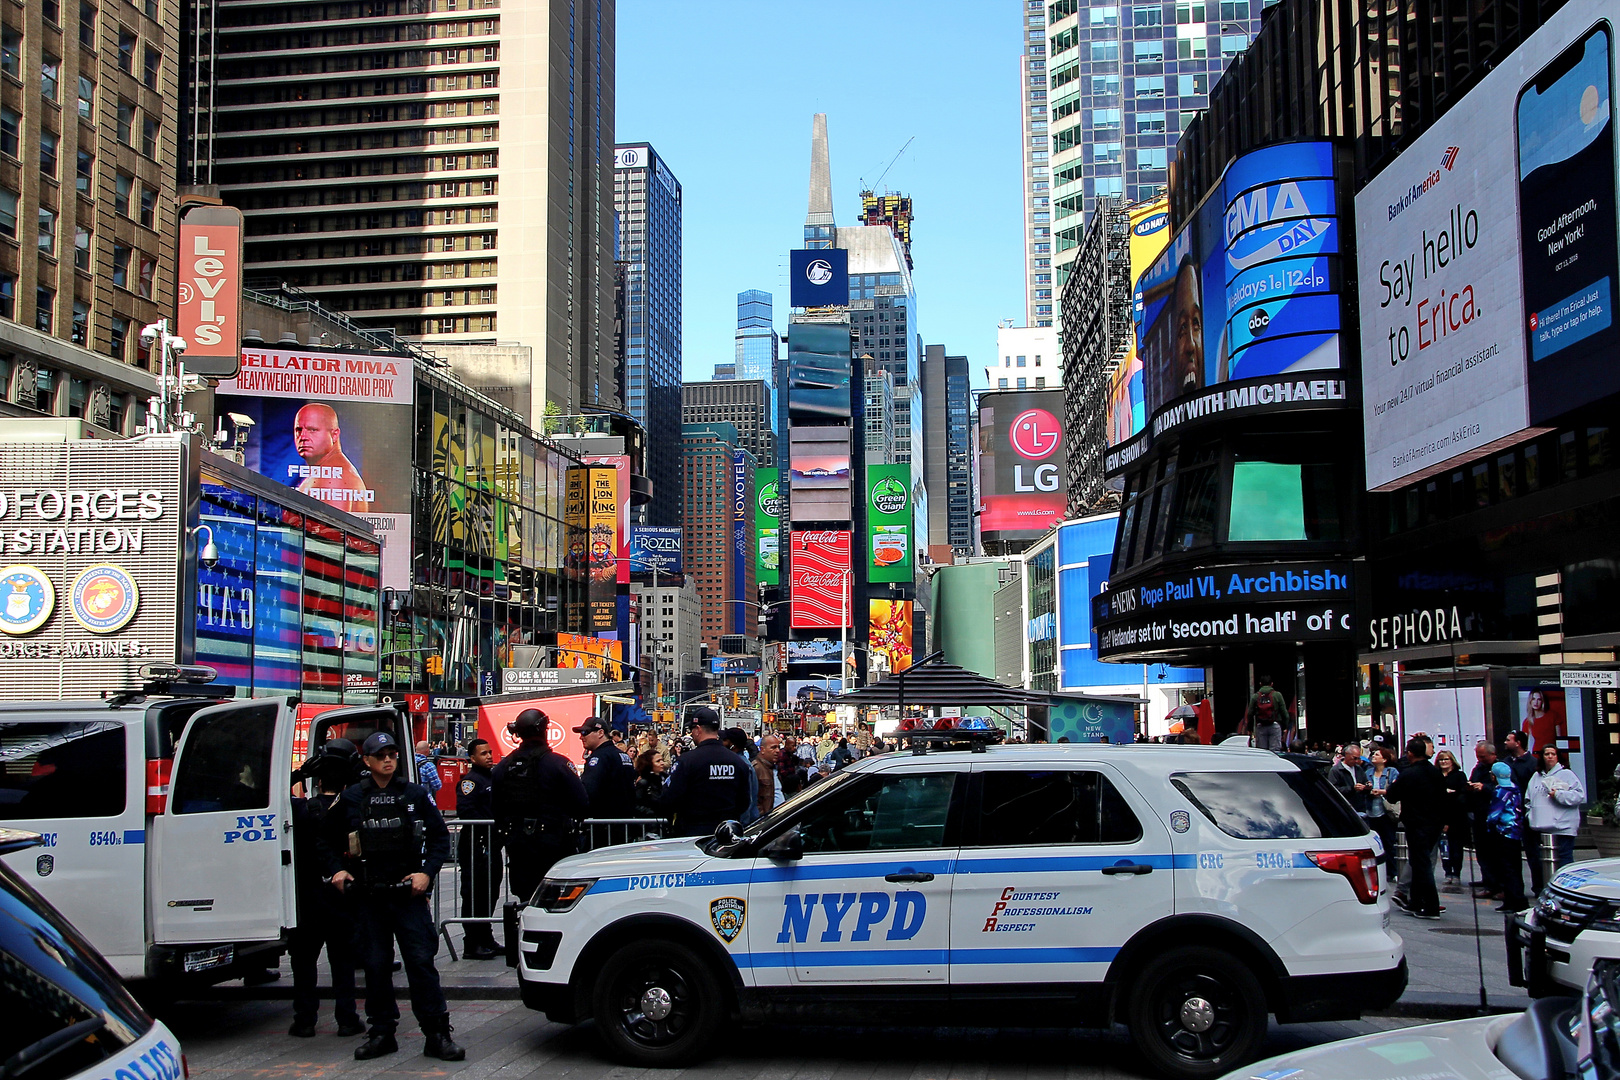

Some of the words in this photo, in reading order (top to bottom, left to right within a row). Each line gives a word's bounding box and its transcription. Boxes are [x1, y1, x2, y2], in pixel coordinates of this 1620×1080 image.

[1388, 196, 1404, 222] Bank
[1405, 188, 1411, 208] of
[1412, 170, 1440, 202] America
[1225, 177, 1312, 250] GMA
[1538, 220, 1556, 242] Good
[1557, 199, 1597, 231] Afternoon,
[1137, 223, 1150, 234] OLD
[1151, 215, 1168, 228] NAVY
[1278, 219, 1318, 253] DAY
[1548, 238, 1564, 256] New
[1564, 224, 1584, 244] York!
[1380, 254, 1415, 308] Say
[1422, 204, 1479, 279] hello
[1569, 254, 1578, 266] 2018
[1228, 280, 1267, 310] Weekdays
[1539, 318, 1545, 328] Hi
[1561, 306, 1569, 317] I'm
[1570, 296, 1585, 312] Erica!
[1586, 290, 1598, 304] Just
[1248, 315, 1270, 330] abc
[1388, 326, 1410, 366] to
[1417, 284, 1482, 350] Erica.
[1551, 325, 1563, 338] type
[1564, 321, 1569, 330] or
[1570, 317, 1579, 327] tap
[1580, 312, 1588, 323] for
[241, 354, 340, 372] BELLATOR
[236, 371, 302, 392] HEAVYWEIGHT
[304, 374, 336, 394] WORLD
[340, 376, 370, 396] GRAND
[372, 378, 394, 398] PRIX
[1374, 402, 1386, 416] Your
[1387, 396, 1399, 410] new
[1400, 385, 1414, 404] 24/7
[1415, 374, 1434, 396] virtual
[1436, 358, 1464, 385] financial
[1465, 342, 1500, 370] assistant.
[1186, 392, 1228, 420] WITH
[1230, 380, 1346, 408] MICHAEL
[1121, 441, 1140, 466] SHOW
[288, 464, 343, 479] FEDOR
[1014, 464, 1059, 492] LG
[594, 488, 612, 499] LION
[734, 458, 745, 521] NOVOTEL
[876, 494, 905, 502] Green
[14, 488, 164, 520] FORCES
[592, 501, 615, 514] KING
[880, 502, 906, 510] Giant
[13, 528, 144, 553] STATION
[634, 535, 680, 551] FROZEN
[801, 531, 840, 543] Coca-Cola
[800, 572, 840, 588] Coca-Cola
[1116, 588, 1136, 614] NEWS
[1141, 586, 1164, 608] Pope
[1166, 578, 1194, 601] Paul
[1197, 576, 1221, 599] VI,
[1138, 624, 1151, 642] set
[1152, 622, 1166, 640] for
[1170, 614, 1238, 639] 'second
[1245, 611, 1296, 634] half'
[1307, 609, 1332, 631] of
[1370, 606, 1462, 650] SEPHORA
[66, 641, 140, 657] MARINES
[519, 671, 531, 679] ICE
[533, 671, 539, 679] &
[541, 671, 558, 679] VICE
[585, 671, 597, 679] 5%
[485, 675, 493, 695] OZEN
[432, 698, 469, 709] SKECH
[1596, 688, 1604, 724] ewsstand
[710, 764, 735, 776] NYPD
[370, 796, 395, 804] POLICE
[236, 814, 276, 829] NY
[224, 828, 277, 844] POL
[1200, 854, 1224, 869] CRC
[630, 873, 684, 891] POLICE
[1001, 887, 1060, 900] COURTESY
[712, 904, 744, 913] DEPARTMENT
[776, 890, 927, 944] NYPD
[991, 902, 1093, 916] PROFESSIONALISM
[982, 918, 1036, 932] RESPECT
